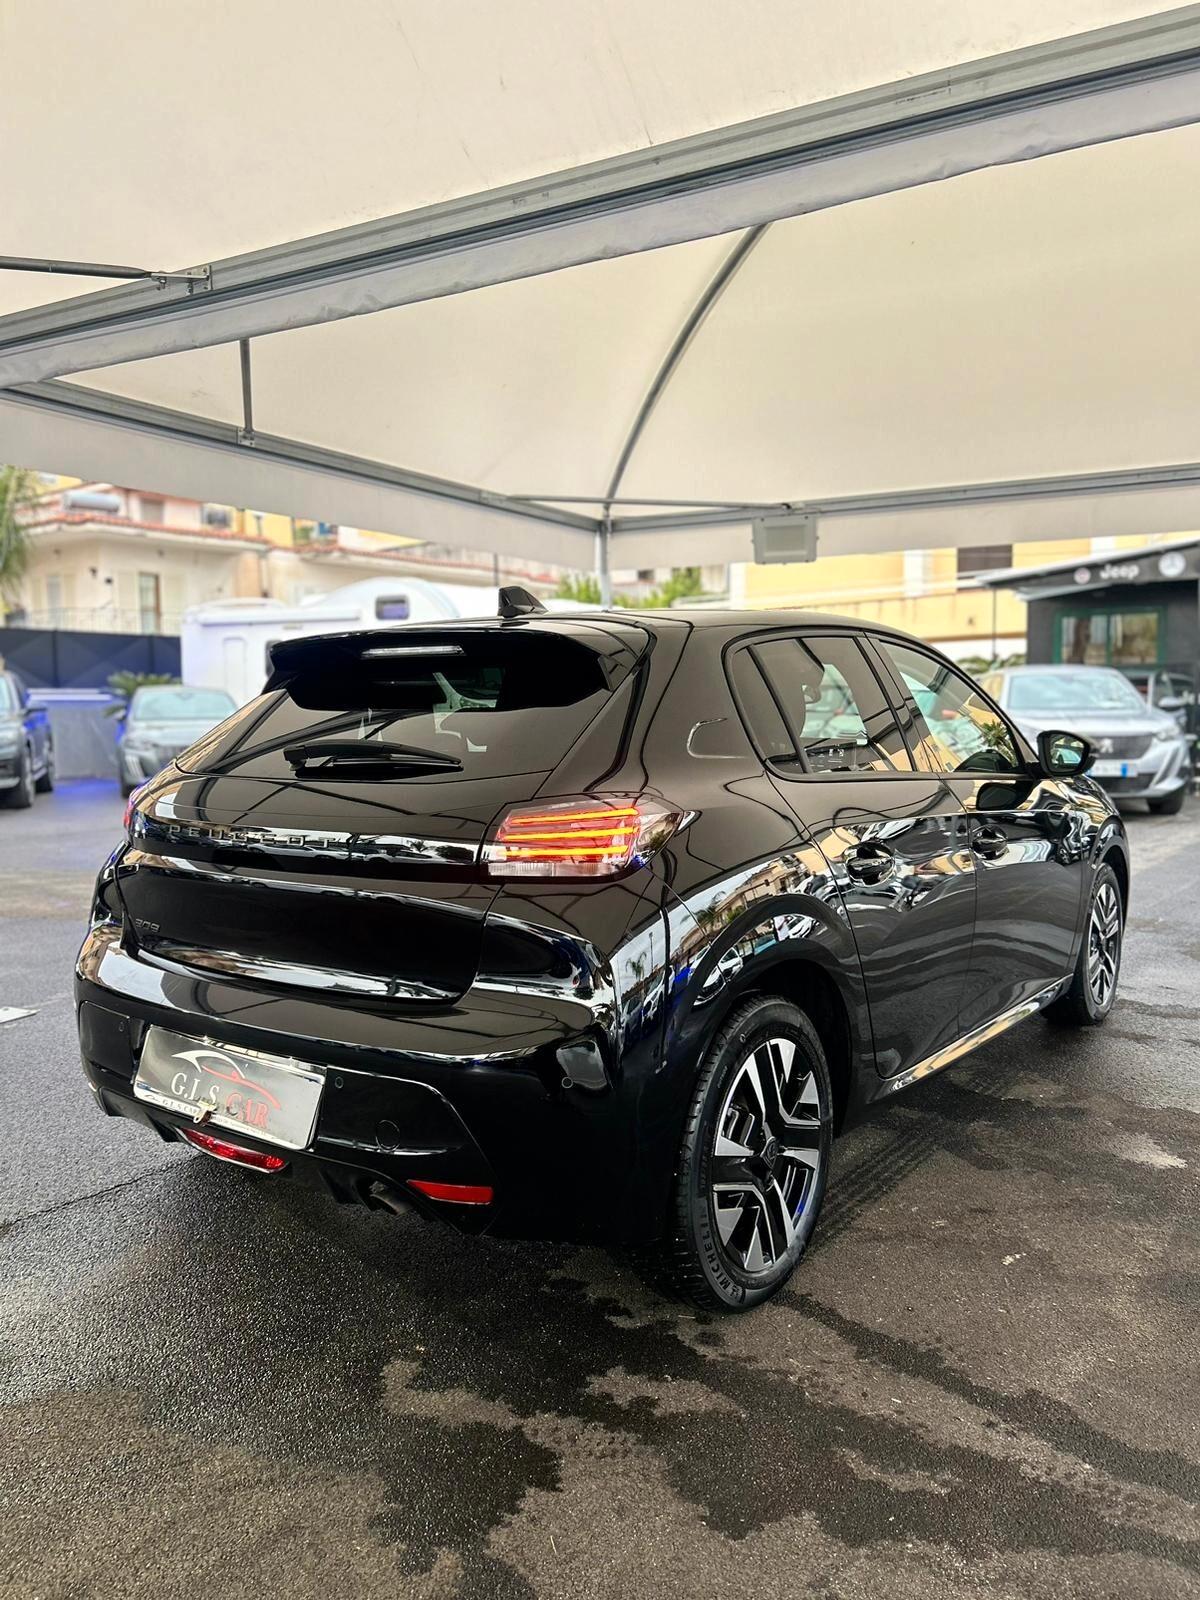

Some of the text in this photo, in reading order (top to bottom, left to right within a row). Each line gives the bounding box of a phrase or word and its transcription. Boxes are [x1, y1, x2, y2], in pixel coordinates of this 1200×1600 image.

[1099, 564, 1140, 580] Jeep
[168, 824, 336, 848] PEUGEOT
[226, 1092, 269, 1128] CAR
